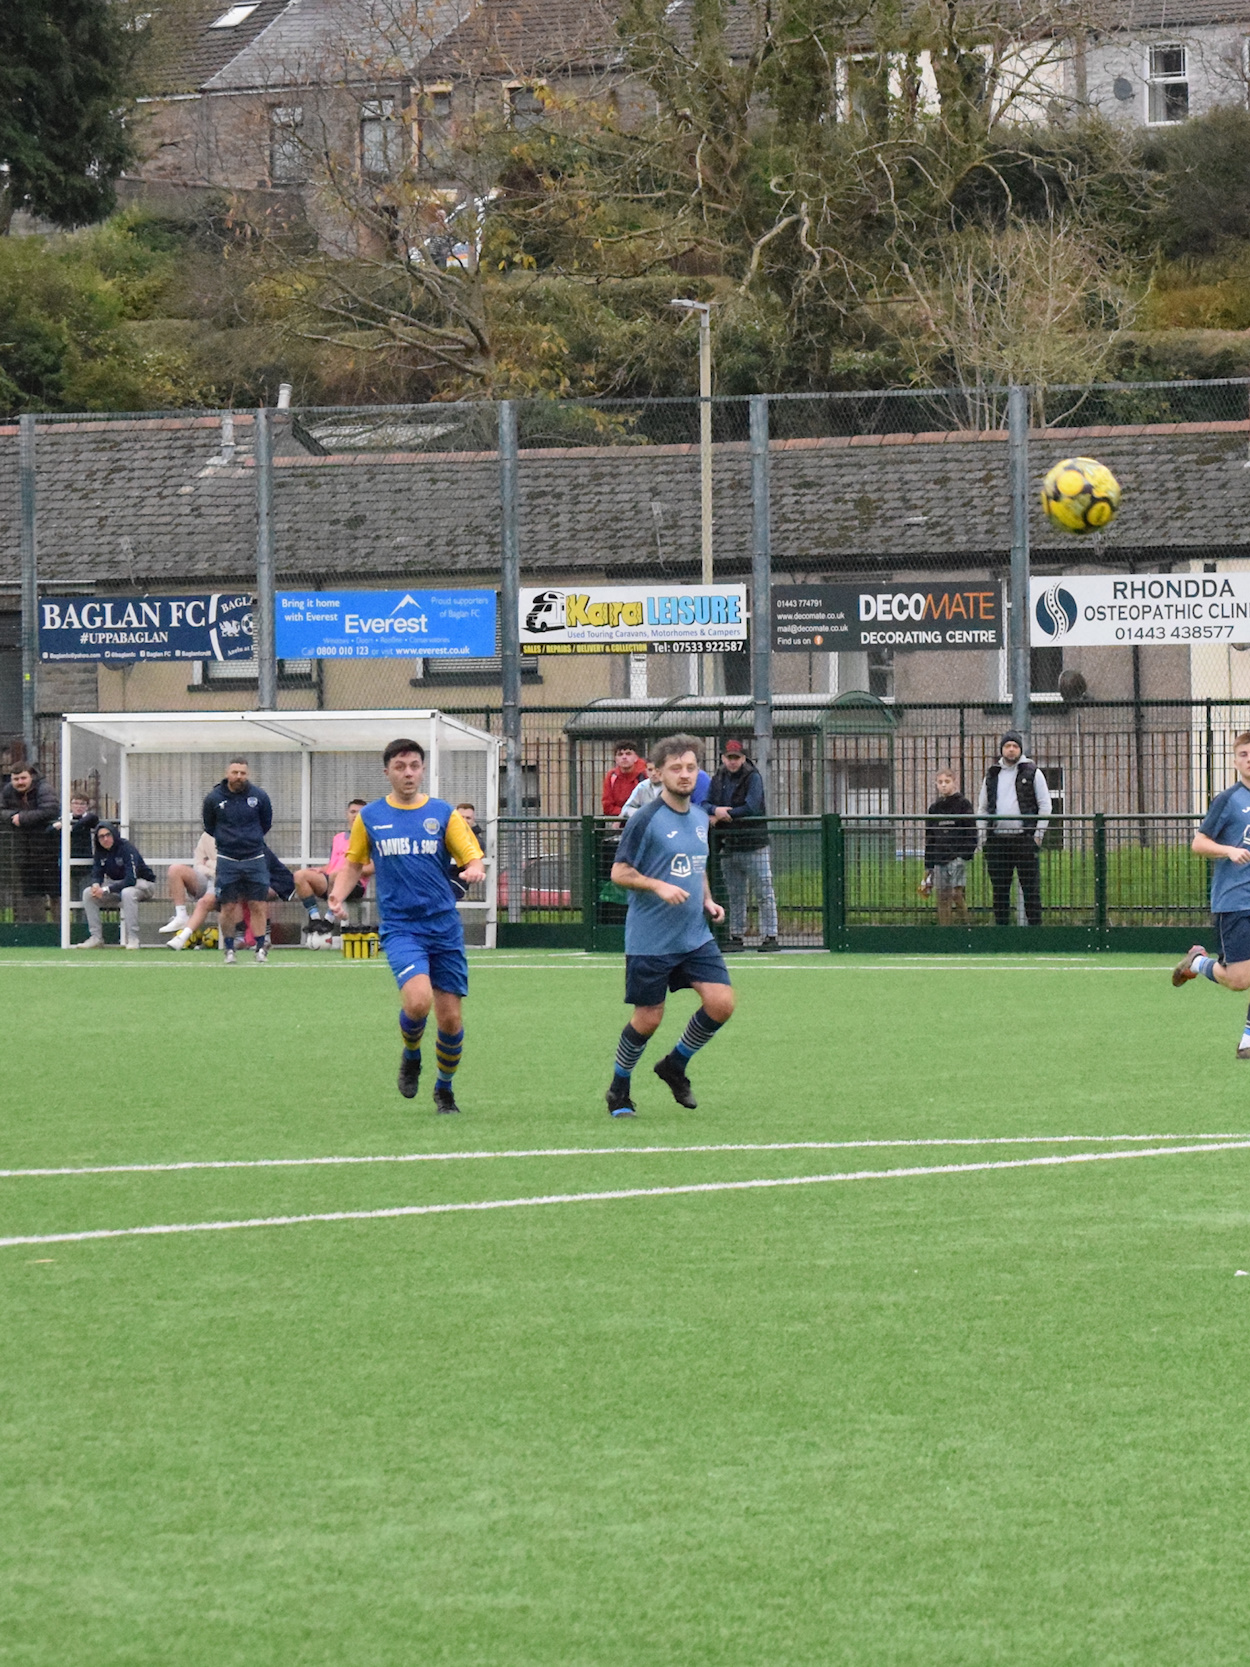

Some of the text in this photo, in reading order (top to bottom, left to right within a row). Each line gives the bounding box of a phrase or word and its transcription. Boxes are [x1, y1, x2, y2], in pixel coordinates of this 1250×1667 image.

[1113, 580, 1235, 600] RHONDDA
[282, 598, 340, 610] Bring it home
[431, 597, 488, 606] Proud supporters
[859, 592, 995, 621] DECOMATE
[42, 601, 206, 629] BAGLAN FC
[284, 612, 338, 622] with Everest
[440, 609, 447, 617] of
[471, 609, 480, 617] FC
[566, 594, 742, 628] Kara LEISURE
[777, 612, 844, 620] www.decomate.co.uk
[1084, 604, 1202, 621] OSTEOPATHIC
[345, 614, 428, 634] Everest
[777, 624, 848, 633] mail@decomate.co.uk
[80, 632, 168, 645] #UPPABAGLAN
[587, 630, 613, 639] Touring
[615, 629, 650, 638] Caravans,
[651, 629, 698, 637] Motorhomes
[708, 628, 740, 638] Campers
[860, 630, 996, 644] DECORATING CENTRE
[1115, 626, 1234, 640] 01443 438577
[317, 646, 337, 655] 0800
[339, 646, 353, 655] 010
[356, 646, 369, 655] 123
[396, 646, 470, 655] www.everest.co.uk
[523, 645, 541, 654] SALES
[546, 644, 571, 653] REPAIRS
[577, 644, 604, 652] DELIVERY
[611, 643, 647, 652] COLLECTION
[653, 641, 743, 652] Tel: 07533 922587
[381, 837, 410, 856] DAVIES
[413, 840, 419, 854] &
